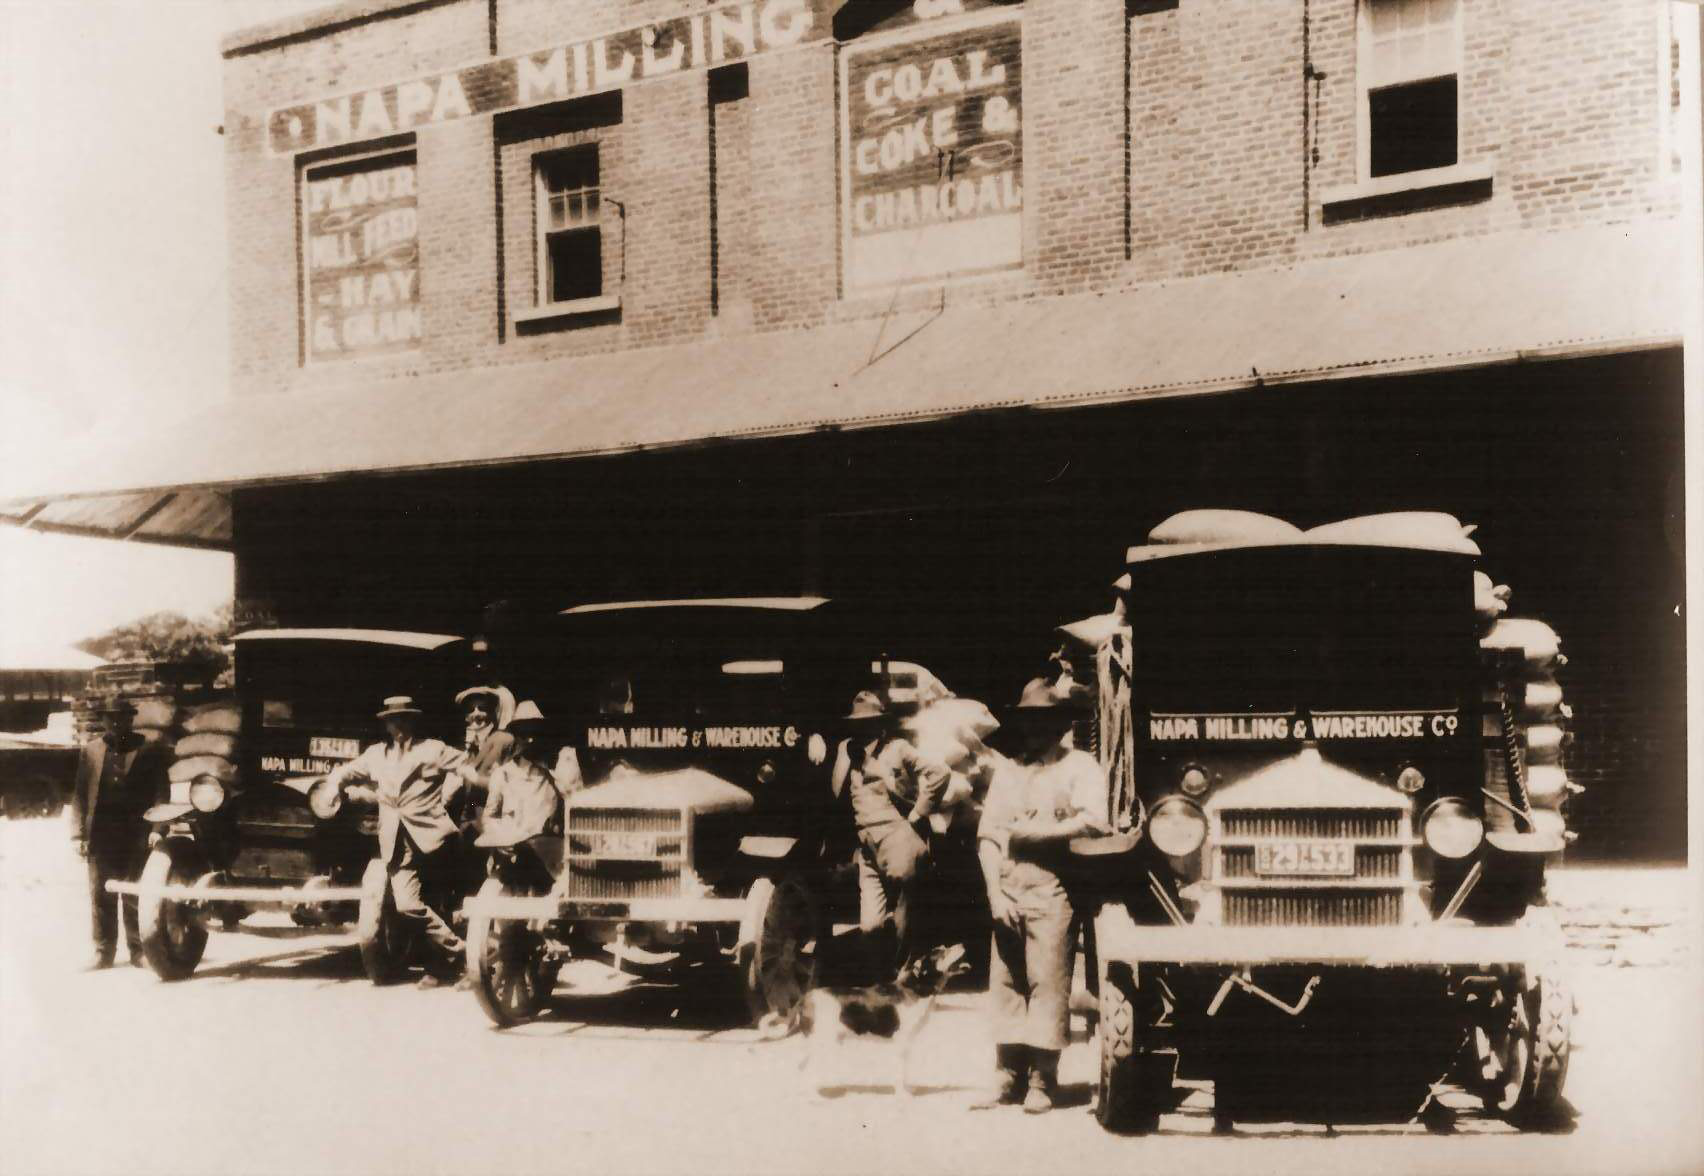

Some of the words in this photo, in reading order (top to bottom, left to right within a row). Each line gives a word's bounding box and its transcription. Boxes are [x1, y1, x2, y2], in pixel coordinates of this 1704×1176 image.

[314, 72, 473, 143] NAPA
[516, 0, 814, 103] MILLING
[864, 50, 1006, 107] COAL
[857, 105, 960, 175] COKE
[982, 95, 1018, 134] &
[308, 167, 416, 213] FLOUR
[855, 170, 1023, 232] CHARCOAL
[340, 270, 416, 309] HAY
[588, 727, 628, 749] NAPA
[630, 727, 688, 748] MILLING
[691, 731, 703, 747] &
[705, 726, 782, 748] WAREHOUSE
[1150, 719, 1199, 740] NAPA
[1205, 718, 1289, 740] MILLING
[1293, 719, 1306, 740] &
[1311, 716, 1425, 738] WAREHOUSE
[261, 756, 287, 772] NAPA
[289, 758, 331, 775] MILLING
